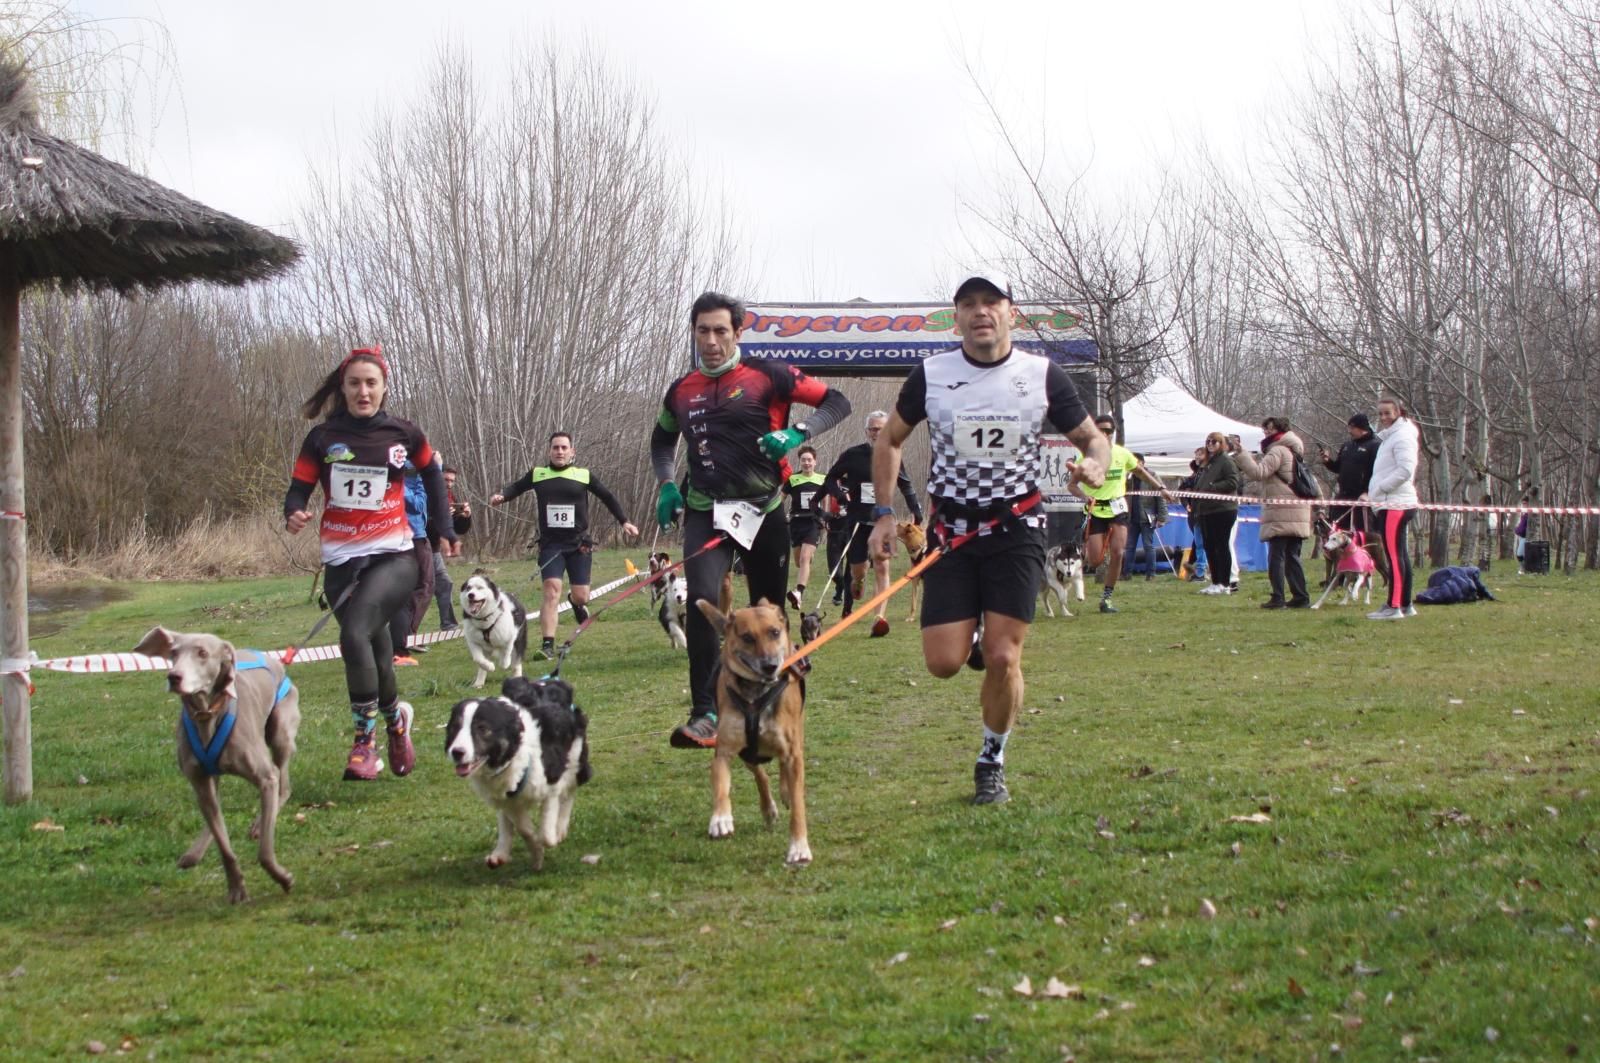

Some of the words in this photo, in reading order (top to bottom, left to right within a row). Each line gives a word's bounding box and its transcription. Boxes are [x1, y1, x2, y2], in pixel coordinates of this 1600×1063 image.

[971, 428, 1004, 448] 12
[344, 480, 371, 498] 13
[553, 512, 568, 522] 18
[730, 512, 742, 529] 5
[323, 521, 357, 536] Mushing
